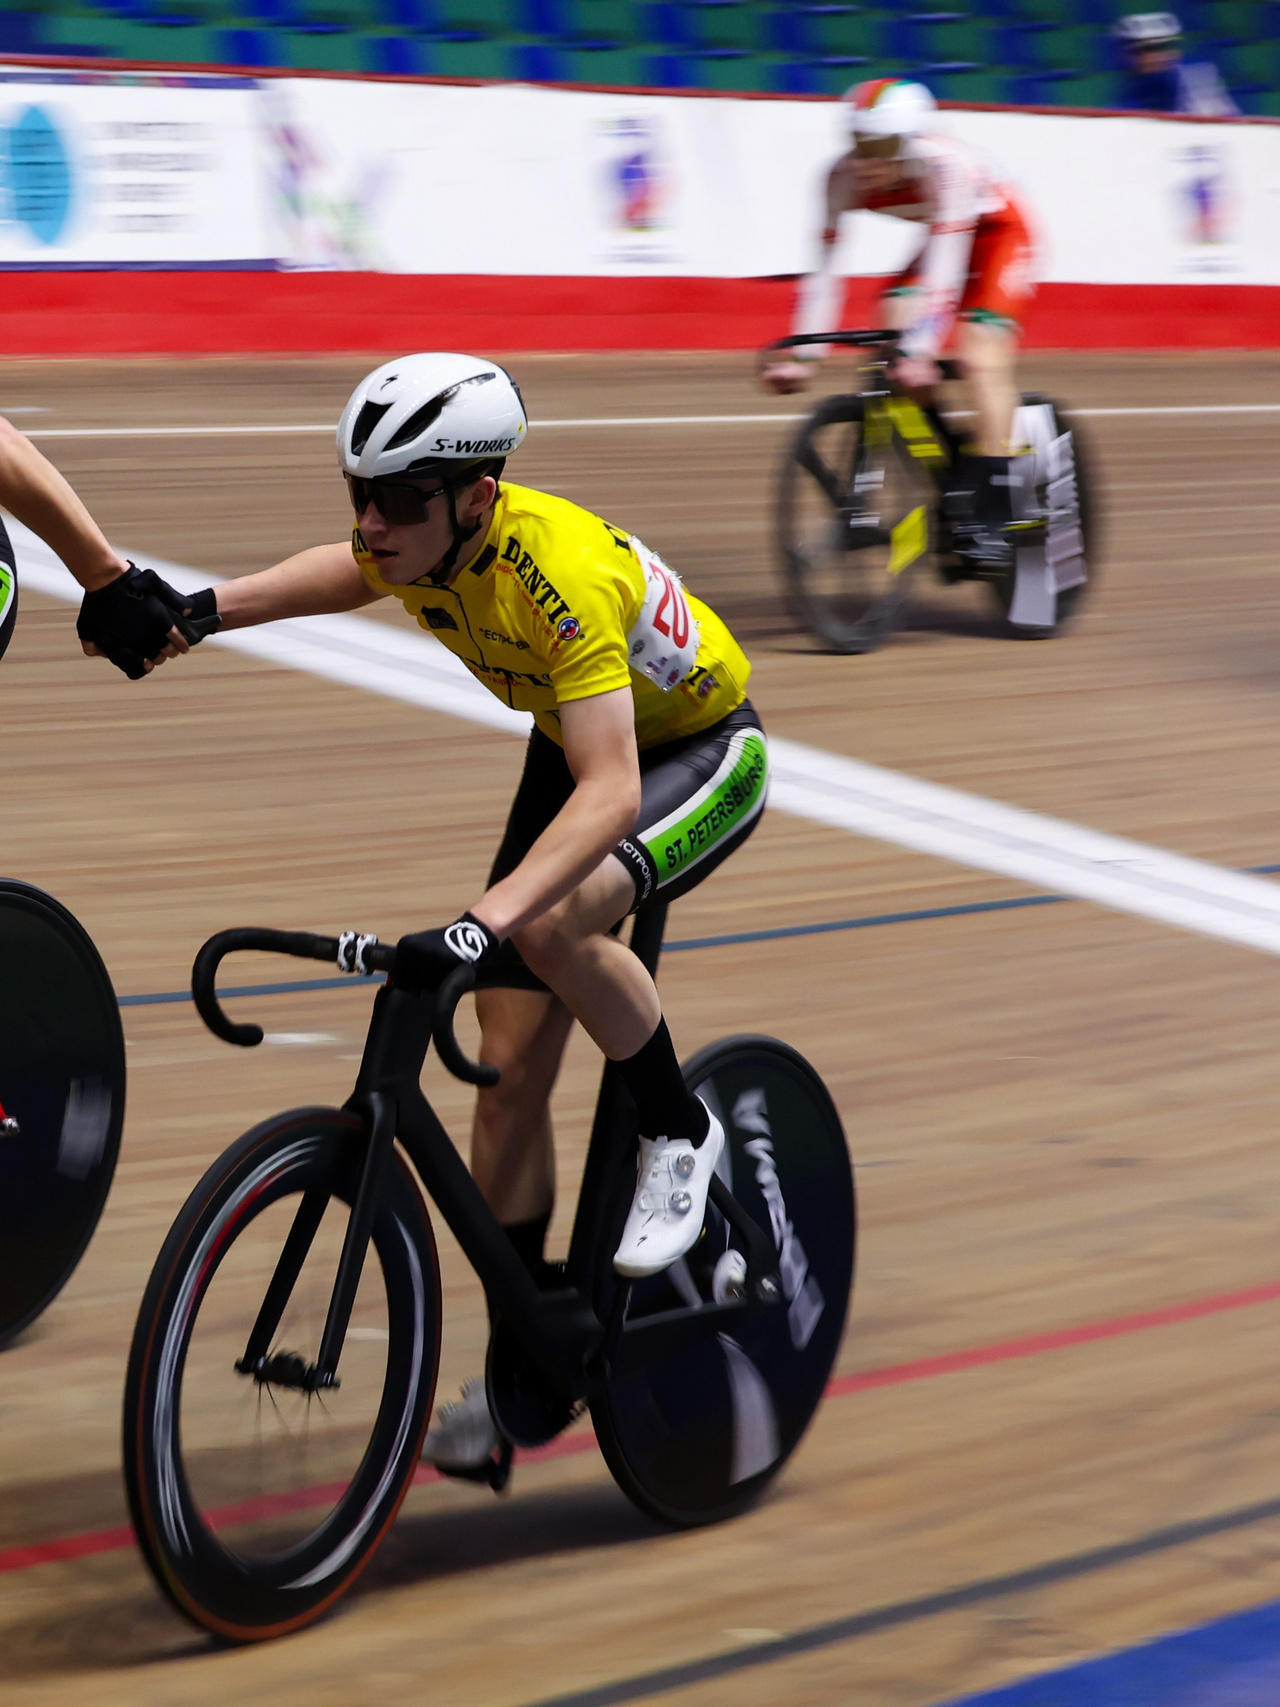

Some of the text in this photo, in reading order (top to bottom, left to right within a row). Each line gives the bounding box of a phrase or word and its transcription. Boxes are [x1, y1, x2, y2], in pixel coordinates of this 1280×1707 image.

[430, 437, 516, 454] S-WORKS
[500, 535, 571, 625] DENTI
[648, 560, 690, 650] 20
[664, 837, 688, 869] ST.
